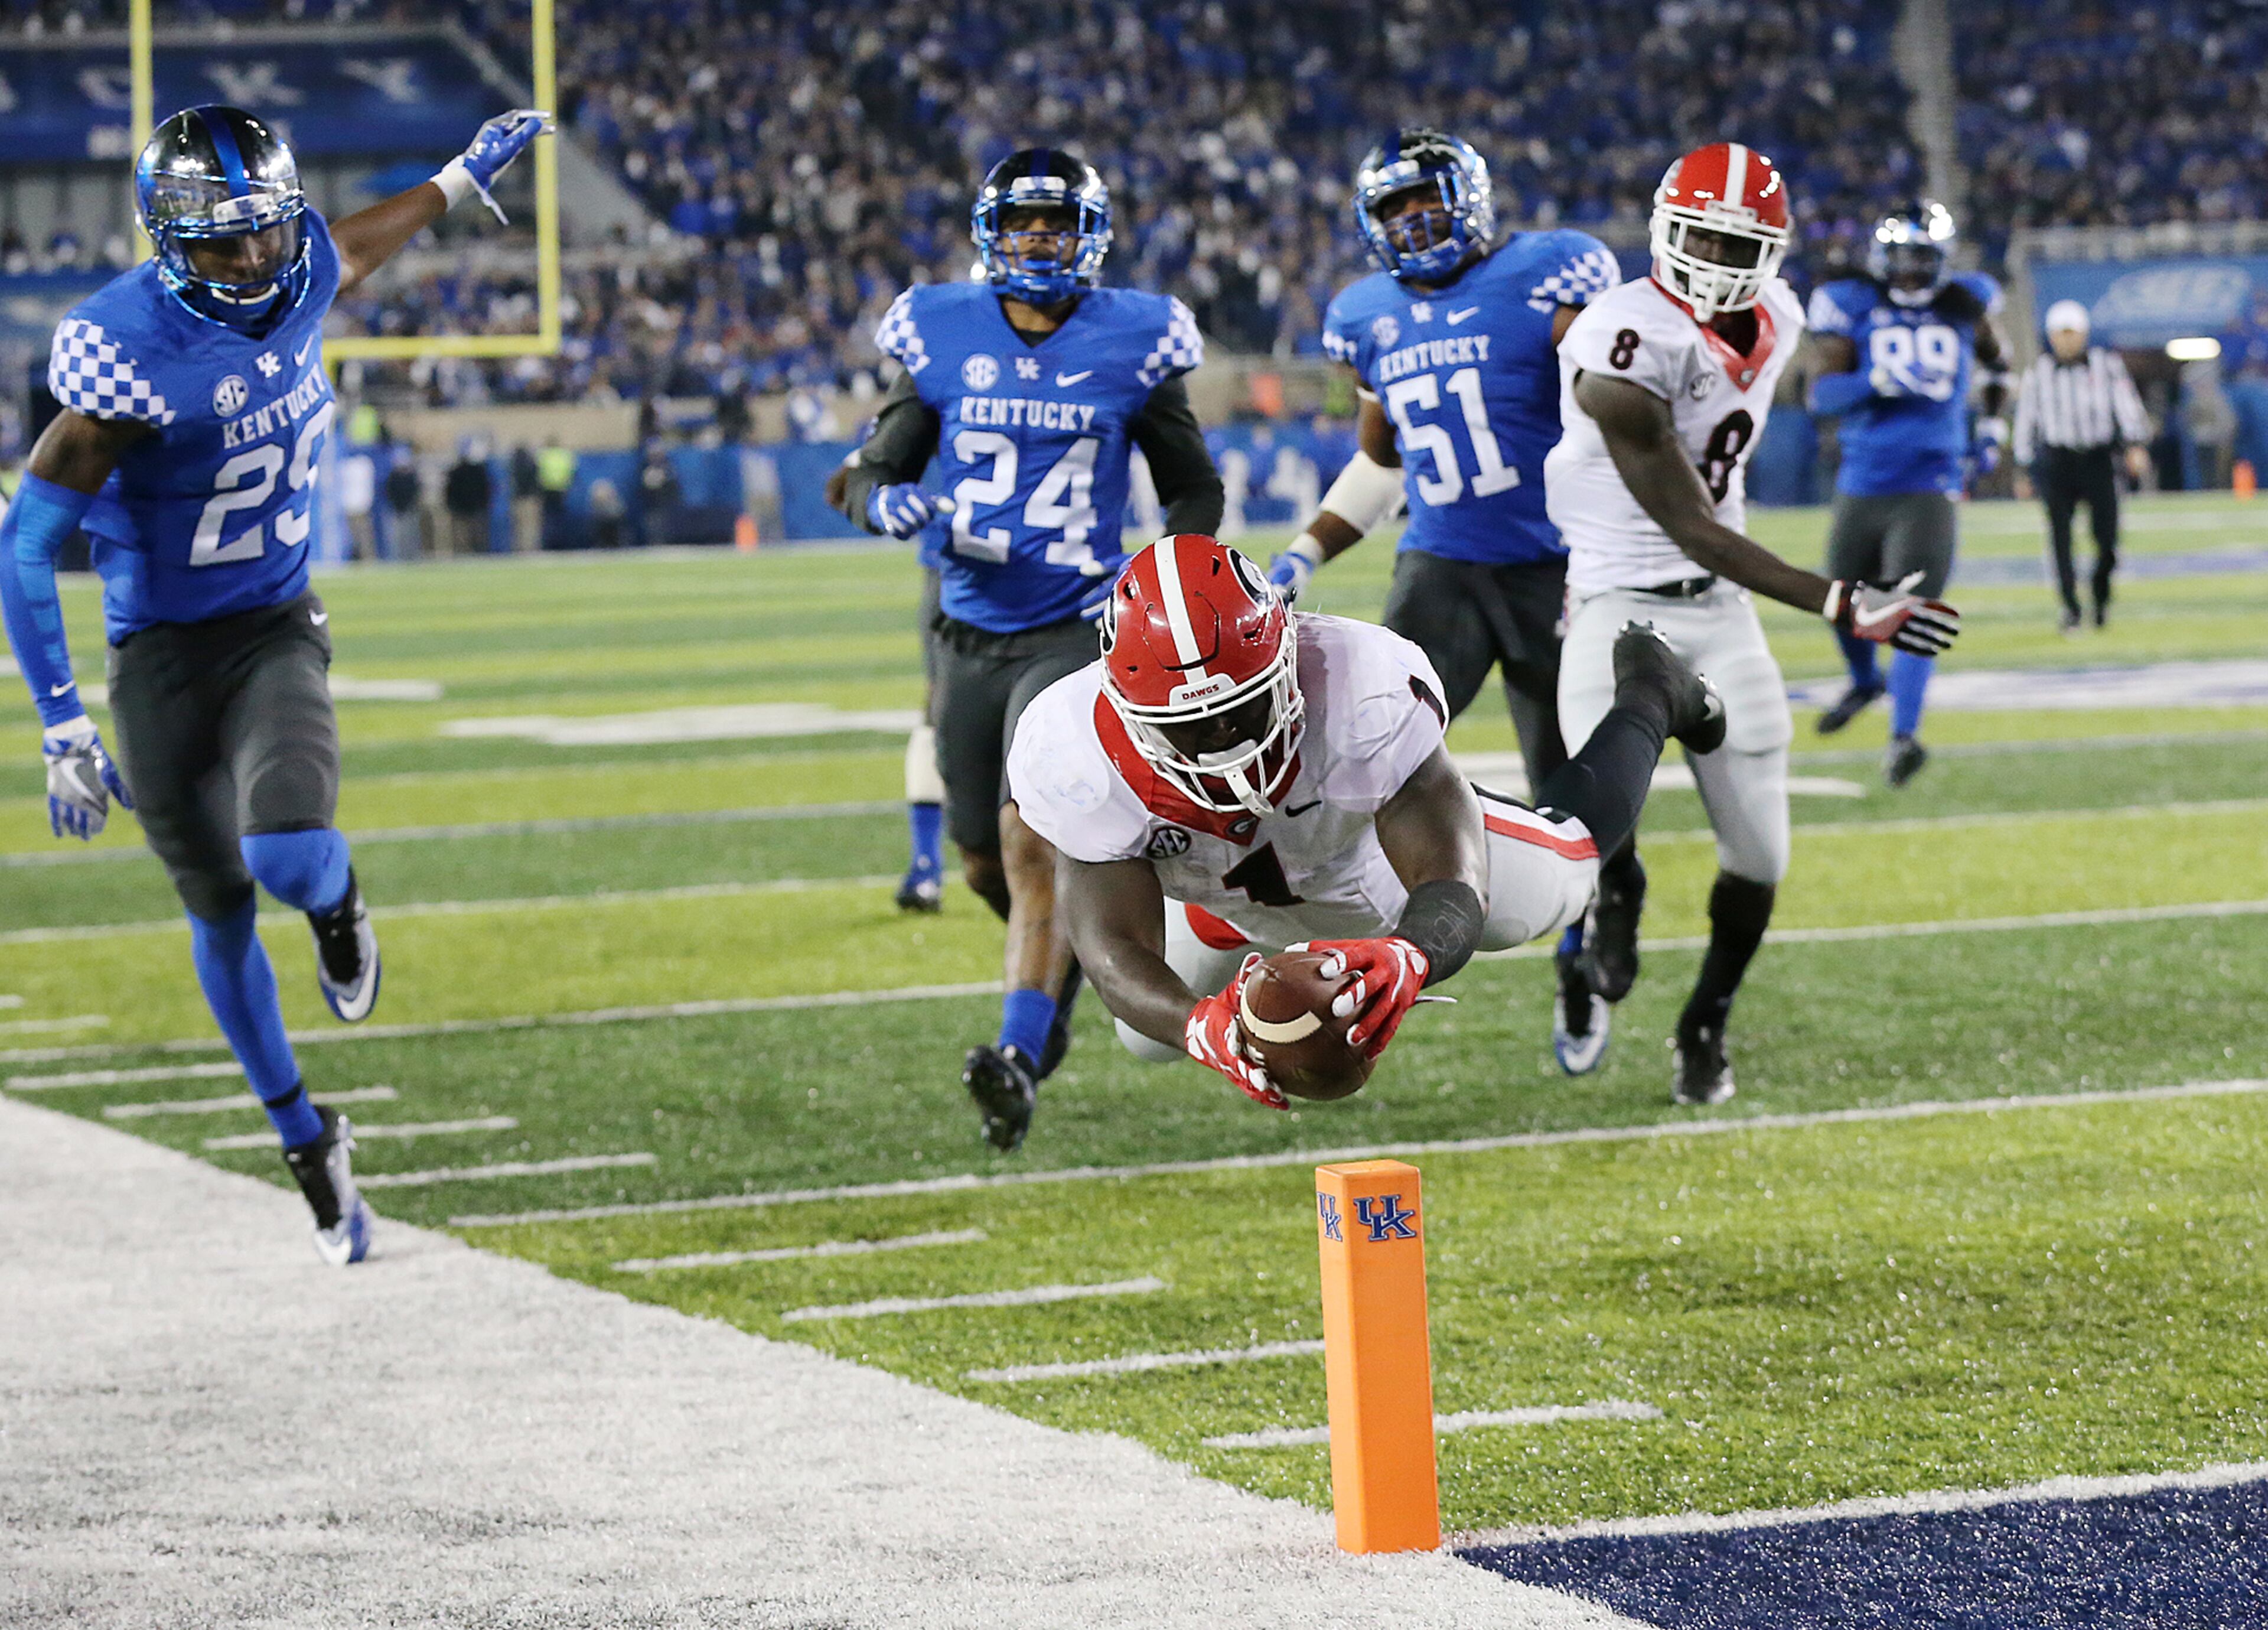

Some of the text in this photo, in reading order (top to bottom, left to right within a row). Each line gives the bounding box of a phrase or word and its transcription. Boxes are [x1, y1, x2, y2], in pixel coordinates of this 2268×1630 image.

[1379, 335, 1491, 382] KENTUCKY
[1609, 328, 1640, 370] 8
[222, 362, 325, 449] KENTUCKY
[959, 396, 1095, 431] KENTUCKY
[1386, 367, 1521, 506] 51
[1697, 409, 1754, 506] 8
[951, 430, 1099, 567] 24
[1182, 684, 1219, 699] DAWGS
[1149, 828, 1188, 857] SEC
[1221, 840, 1306, 907] 1
[1317, 1191, 1342, 1241] UK
[1353, 1194, 1416, 1241] UK
